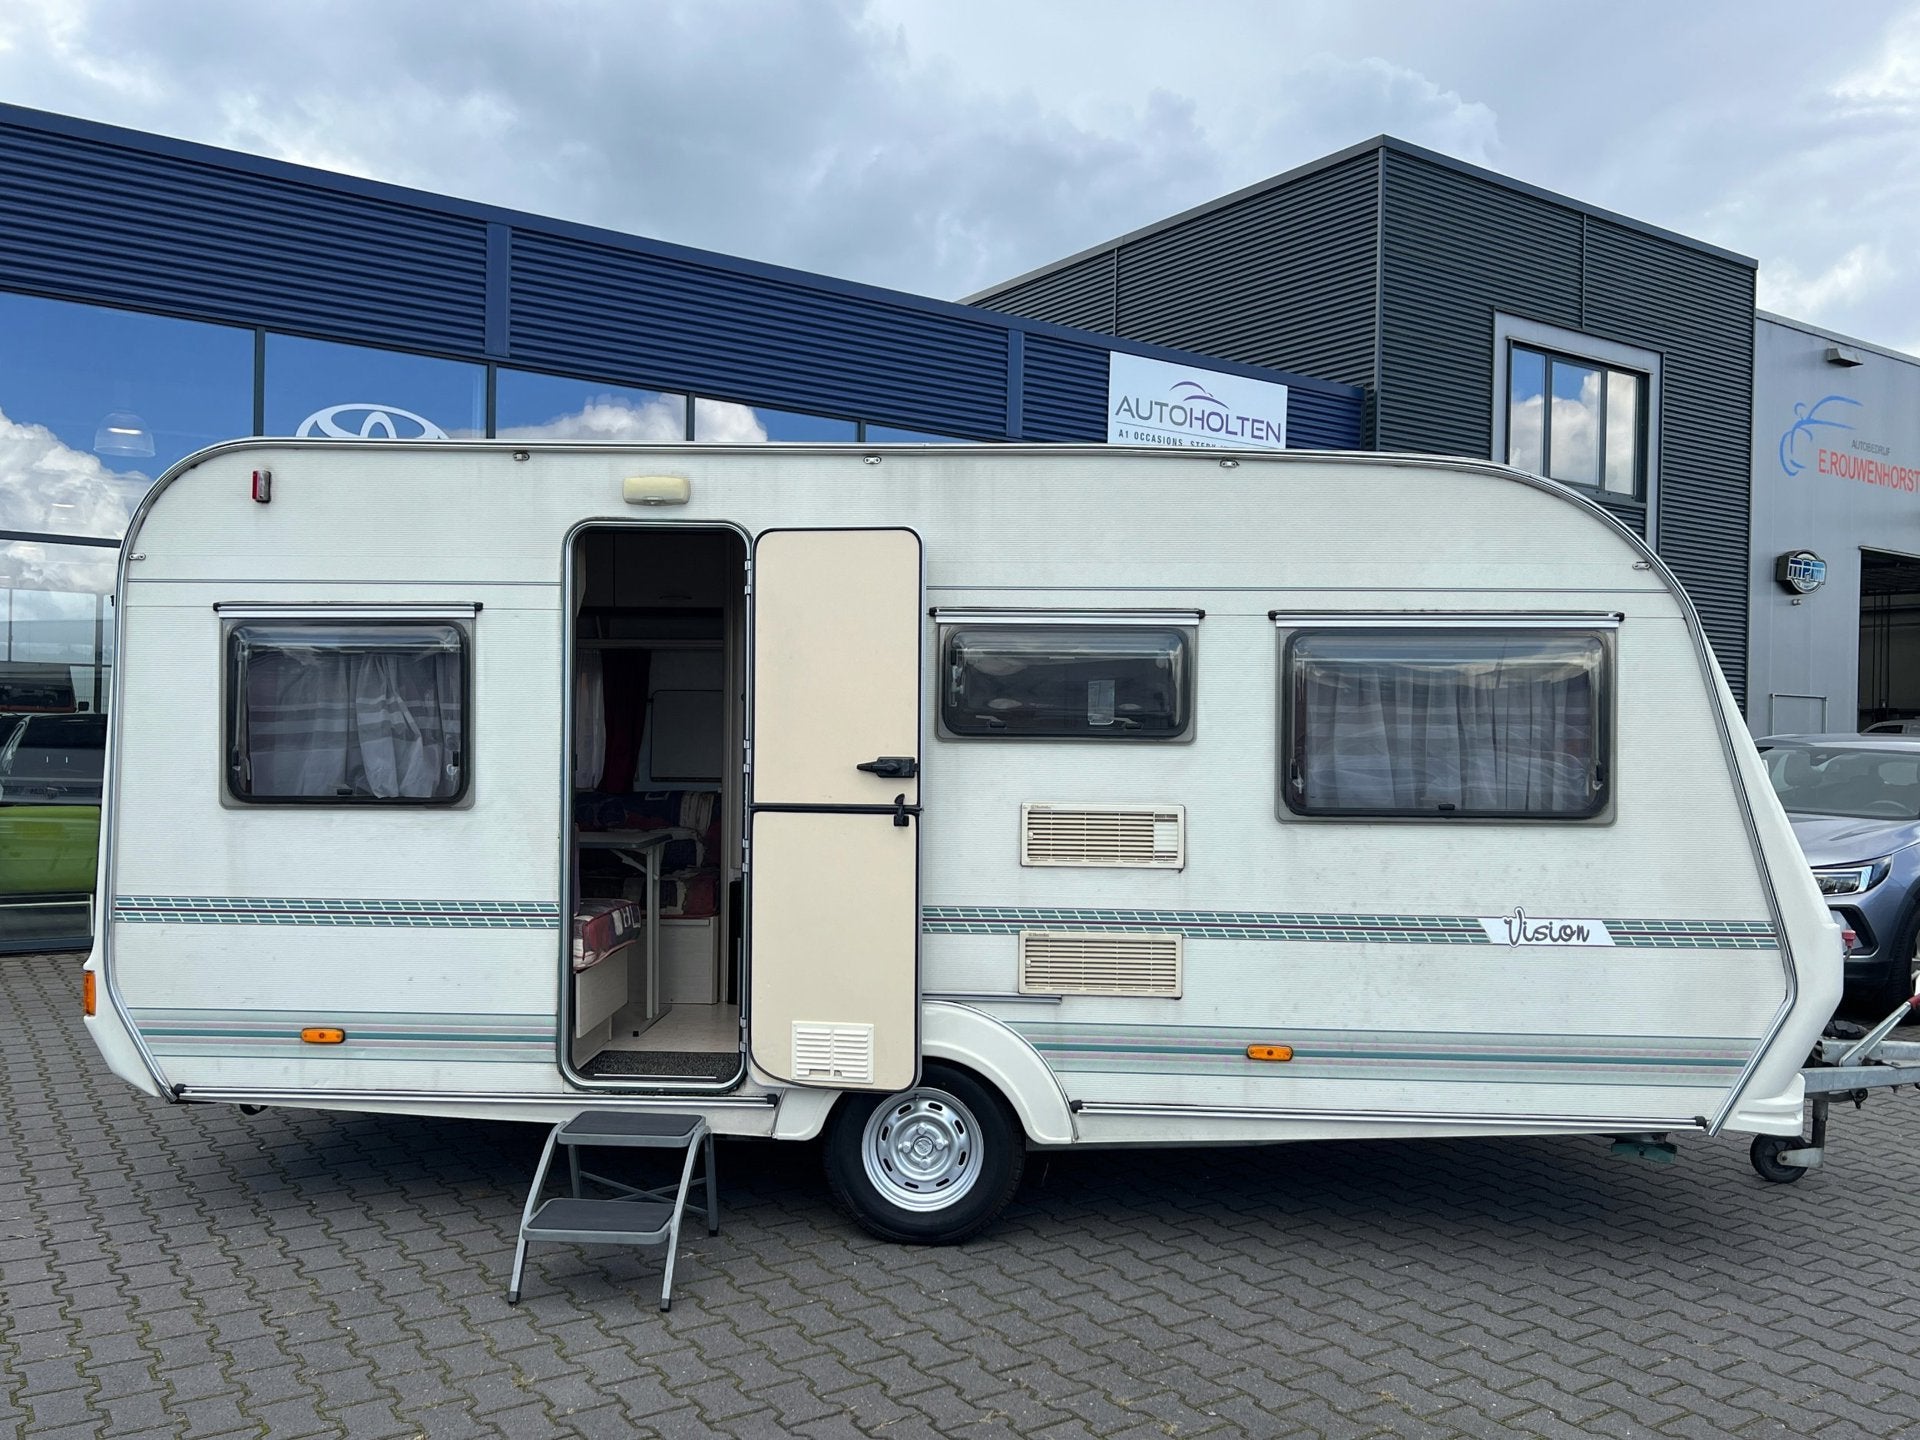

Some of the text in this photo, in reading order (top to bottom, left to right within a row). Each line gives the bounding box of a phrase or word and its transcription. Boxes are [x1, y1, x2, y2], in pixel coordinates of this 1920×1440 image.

[1115, 395, 1282, 443] AUTOHOLTEN
[1118, 429, 1129, 439] A1
[1133, 431, 1183, 447] OCCASIONS
[1818, 448, 1920, 494] E.ROUWENHORST
[1503, 907, 1590, 946] Vision
